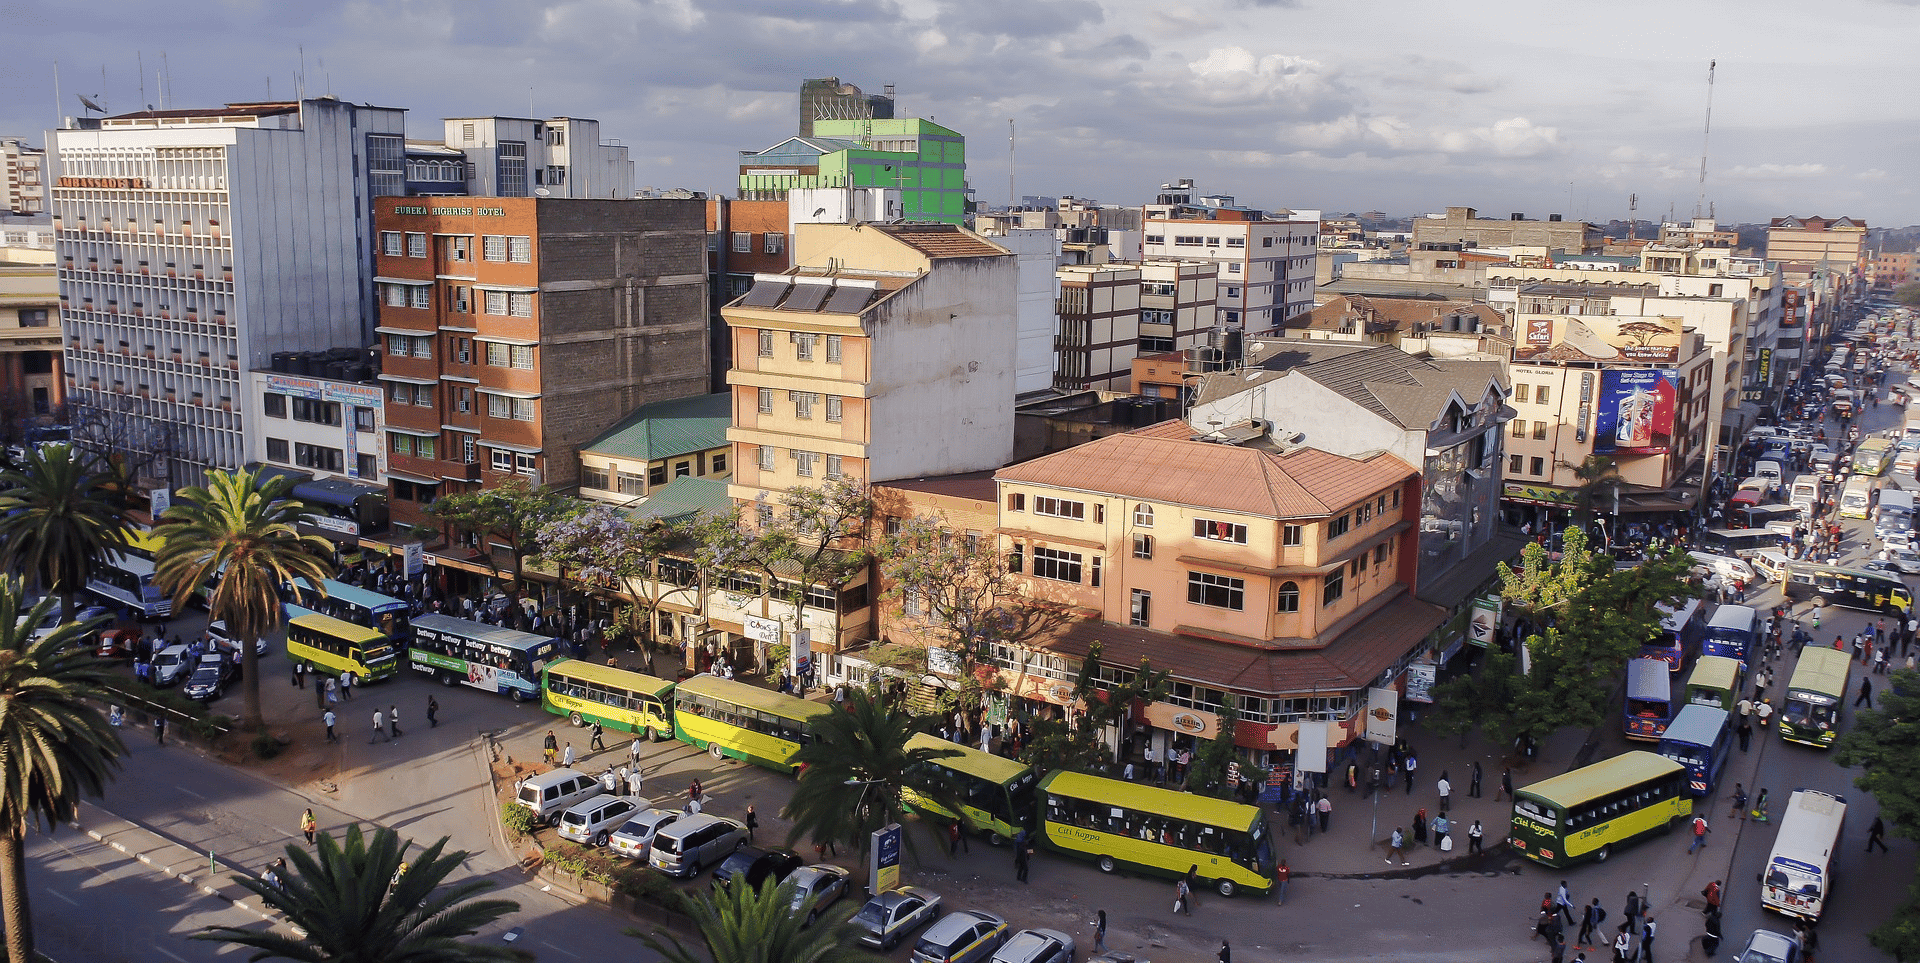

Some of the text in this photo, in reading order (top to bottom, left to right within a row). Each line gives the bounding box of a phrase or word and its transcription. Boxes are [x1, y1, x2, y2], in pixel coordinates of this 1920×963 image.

[395, 206, 505, 217] EUREKA HIGHRISE HOTEL
[1760, 349, 1770, 382] TUSKYS
[417, 628, 511, 656] betway betway betway betway
[412, 662, 435, 675] betway
[1057, 826, 1100, 841] Citi hoppa
